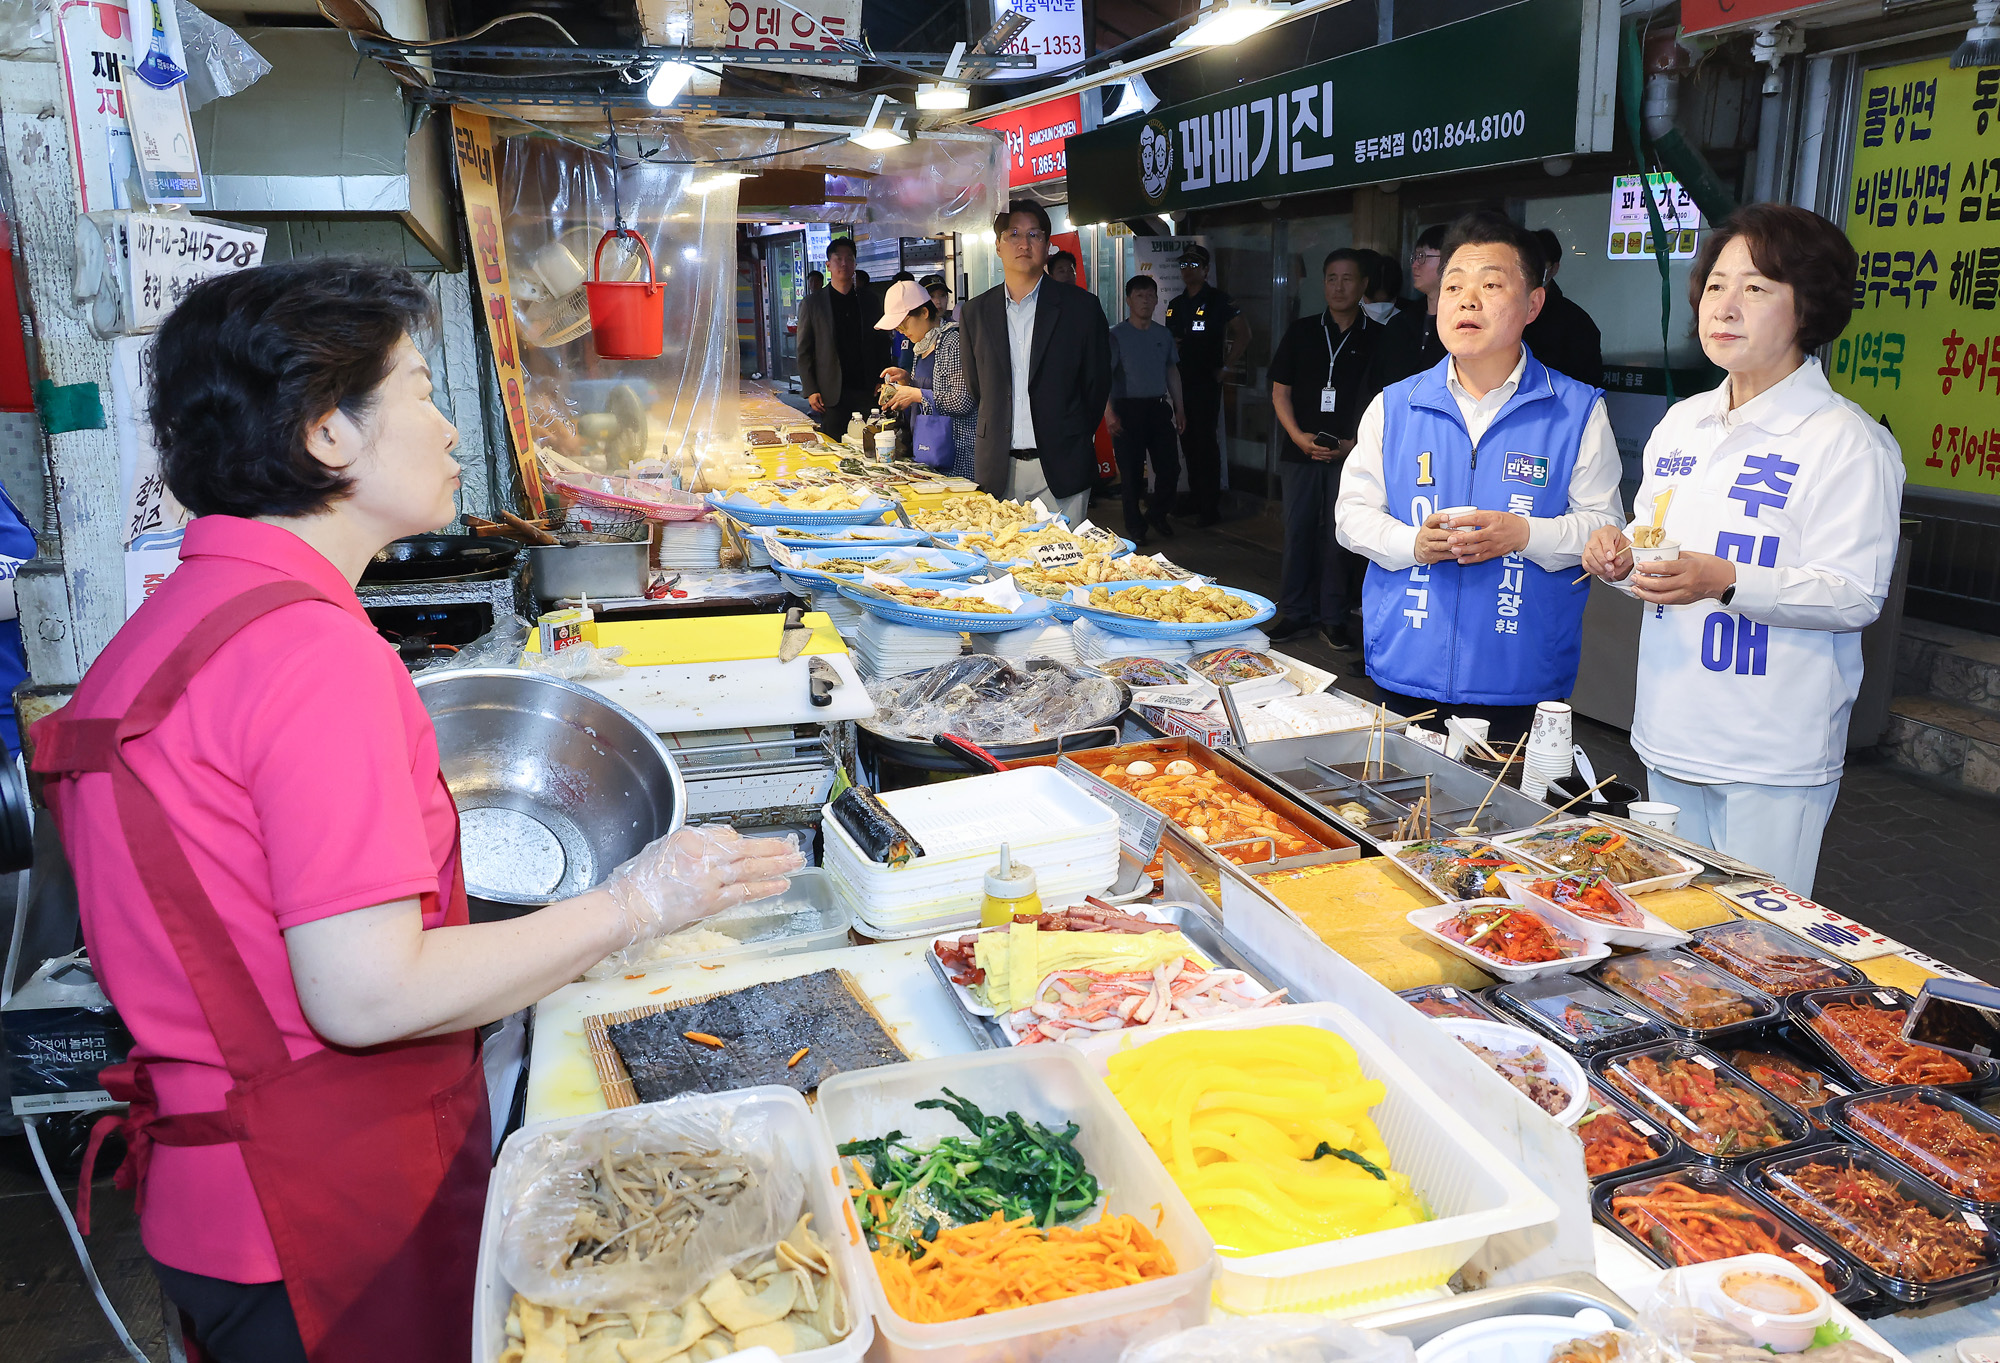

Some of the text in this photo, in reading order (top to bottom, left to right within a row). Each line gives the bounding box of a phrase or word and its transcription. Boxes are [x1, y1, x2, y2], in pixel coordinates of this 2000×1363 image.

[1053, 119, 1077, 139] CHICKEN
[1863, 77, 1938, 147] 물냉면
[1178, 80, 1334, 192] 꽈배기진
[1354, 109, 1526, 164] 동두천점 031.864.8100
[1855, 162, 1951, 227] 비빔냉면
[1836, 331, 1906, 391] 미역국
[1415, 451, 1435, 488] 1
[1507, 462, 1546, 479] 민주당
[1655, 456, 1698, 477] 민주당
[130, 504, 163, 538] 치즈
[1701, 453, 1800, 676] 추미애
[1494, 619, 1518, 635] 후보
[1736, 889, 1861, 947] 홍어
[68, 1037, 107, 1050] 놀라고
[70, 1050, 108, 1063] 반하다
